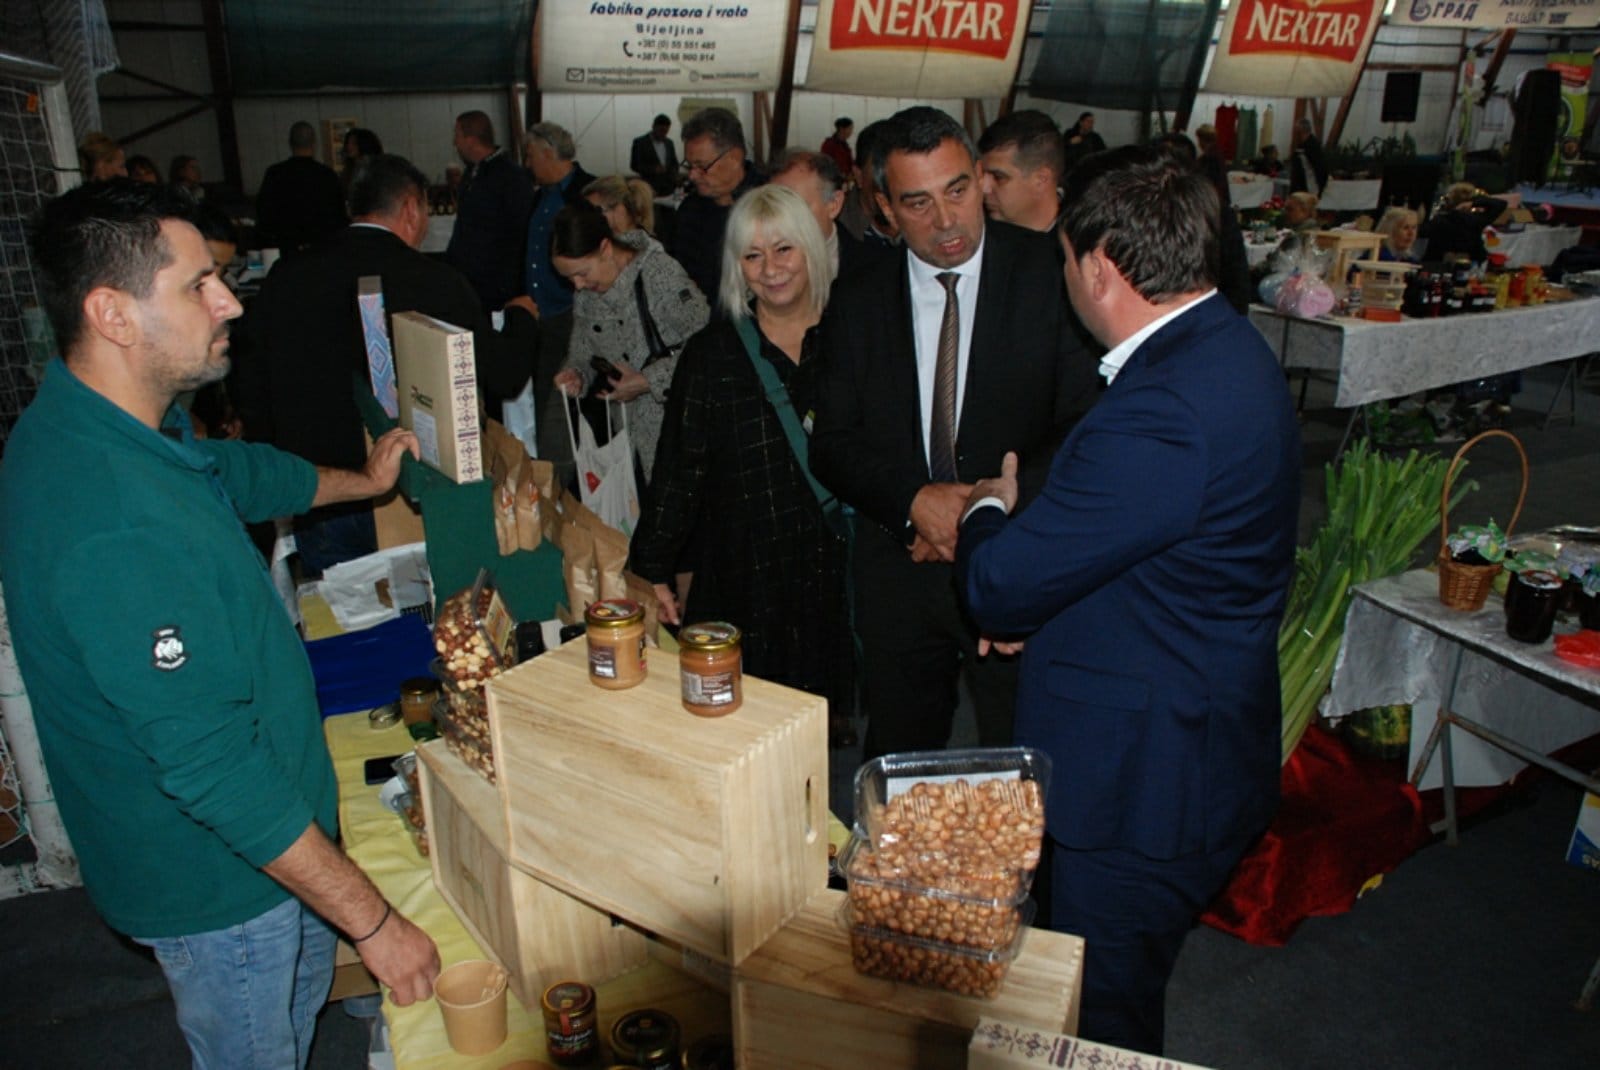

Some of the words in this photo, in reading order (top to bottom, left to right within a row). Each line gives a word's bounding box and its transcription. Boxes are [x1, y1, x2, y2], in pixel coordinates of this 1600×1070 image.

[590, 2, 643, 15] fabrika
[646, 6, 702, 19] prozora
[706, 5, 714, 17] i
[848, 0, 1004, 41] NEKTAR
[1245, 0, 1361, 47] NEKTAR
[635, 23, 704, 37] Bijeljina
